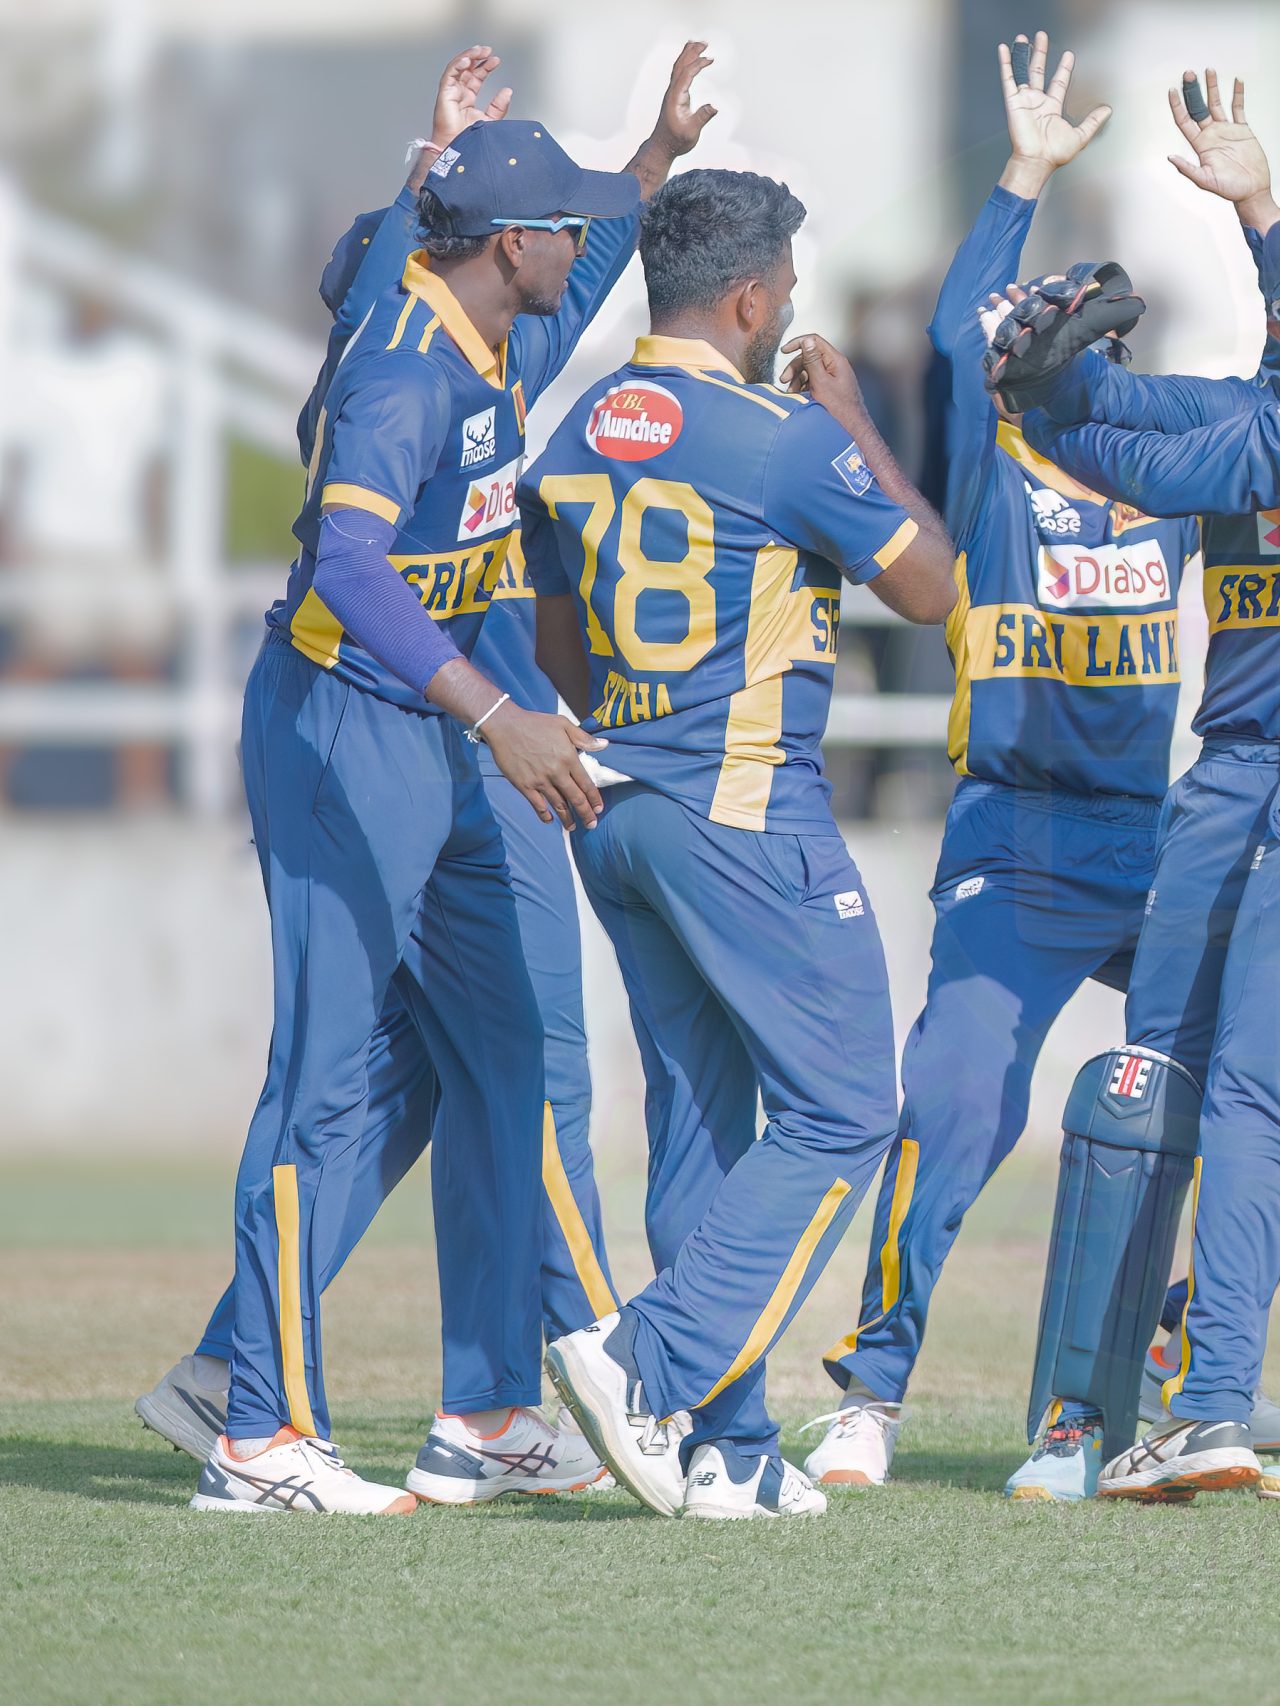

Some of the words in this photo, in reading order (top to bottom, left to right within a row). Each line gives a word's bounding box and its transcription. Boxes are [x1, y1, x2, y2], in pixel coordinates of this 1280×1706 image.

[612, 393, 647, 411] CBL
[596, 409, 672, 444] Munchee
[460, 438, 496, 467] moose
[486, 481, 515, 524] Dia
[539, 474, 717, 671] 78
[811, 597, 840, 654] SR
[993, 614, 1065, 675] SRI
[1085, 620, 1178, 677] LANK
